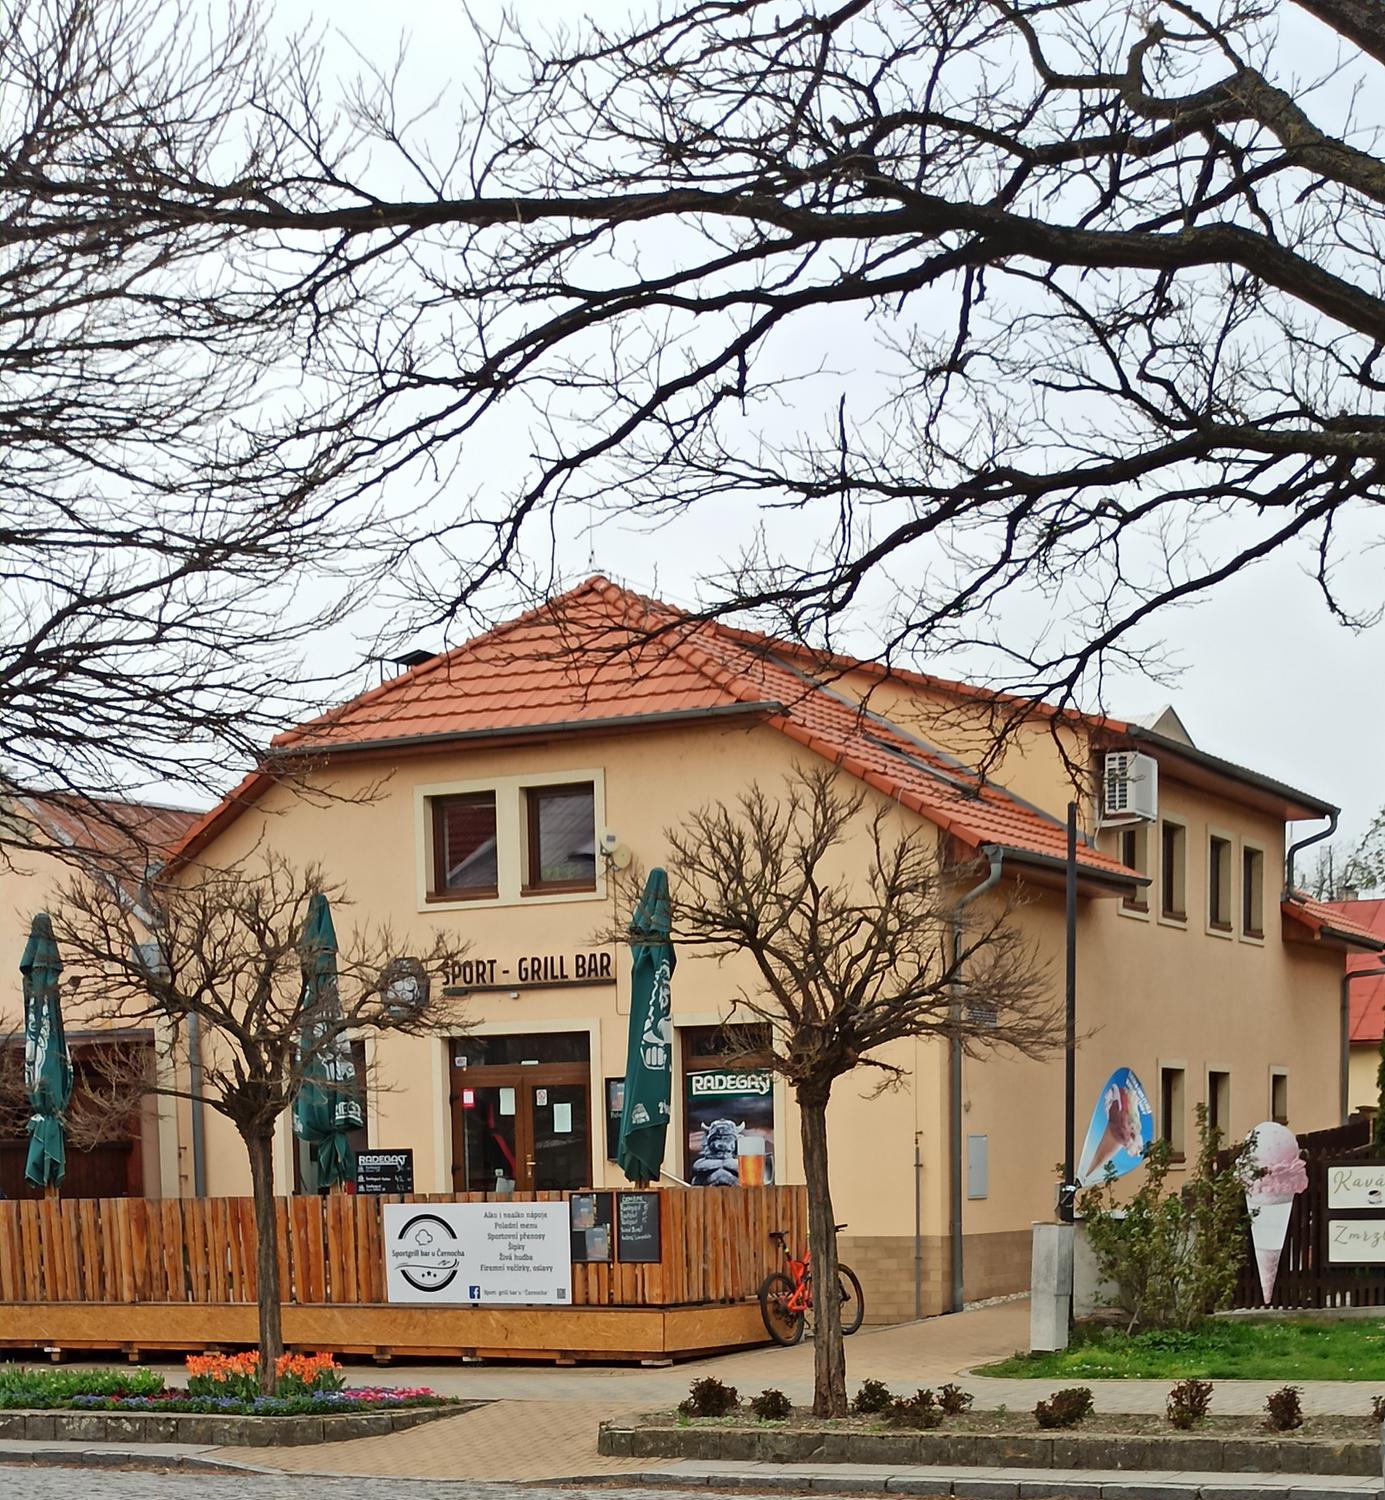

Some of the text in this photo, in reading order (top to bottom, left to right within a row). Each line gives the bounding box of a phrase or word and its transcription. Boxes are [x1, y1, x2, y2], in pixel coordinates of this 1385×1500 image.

[442, 959, 497, 986] SPORT
[518, 955, 568, 982] GRILL
[575, 952, 611, 978] BAR
[359, 1155, 407, 1166] RADEGAST
[1333, 1170, 1385, 1194] Kavá
[1333, 1225, 1385, 1248] Zmrz
[392, 1249, 419, 1259] Sportgrill
[420, 1249, 430, 1257] bar
[436, 1248, 465, 1257] Černocha
